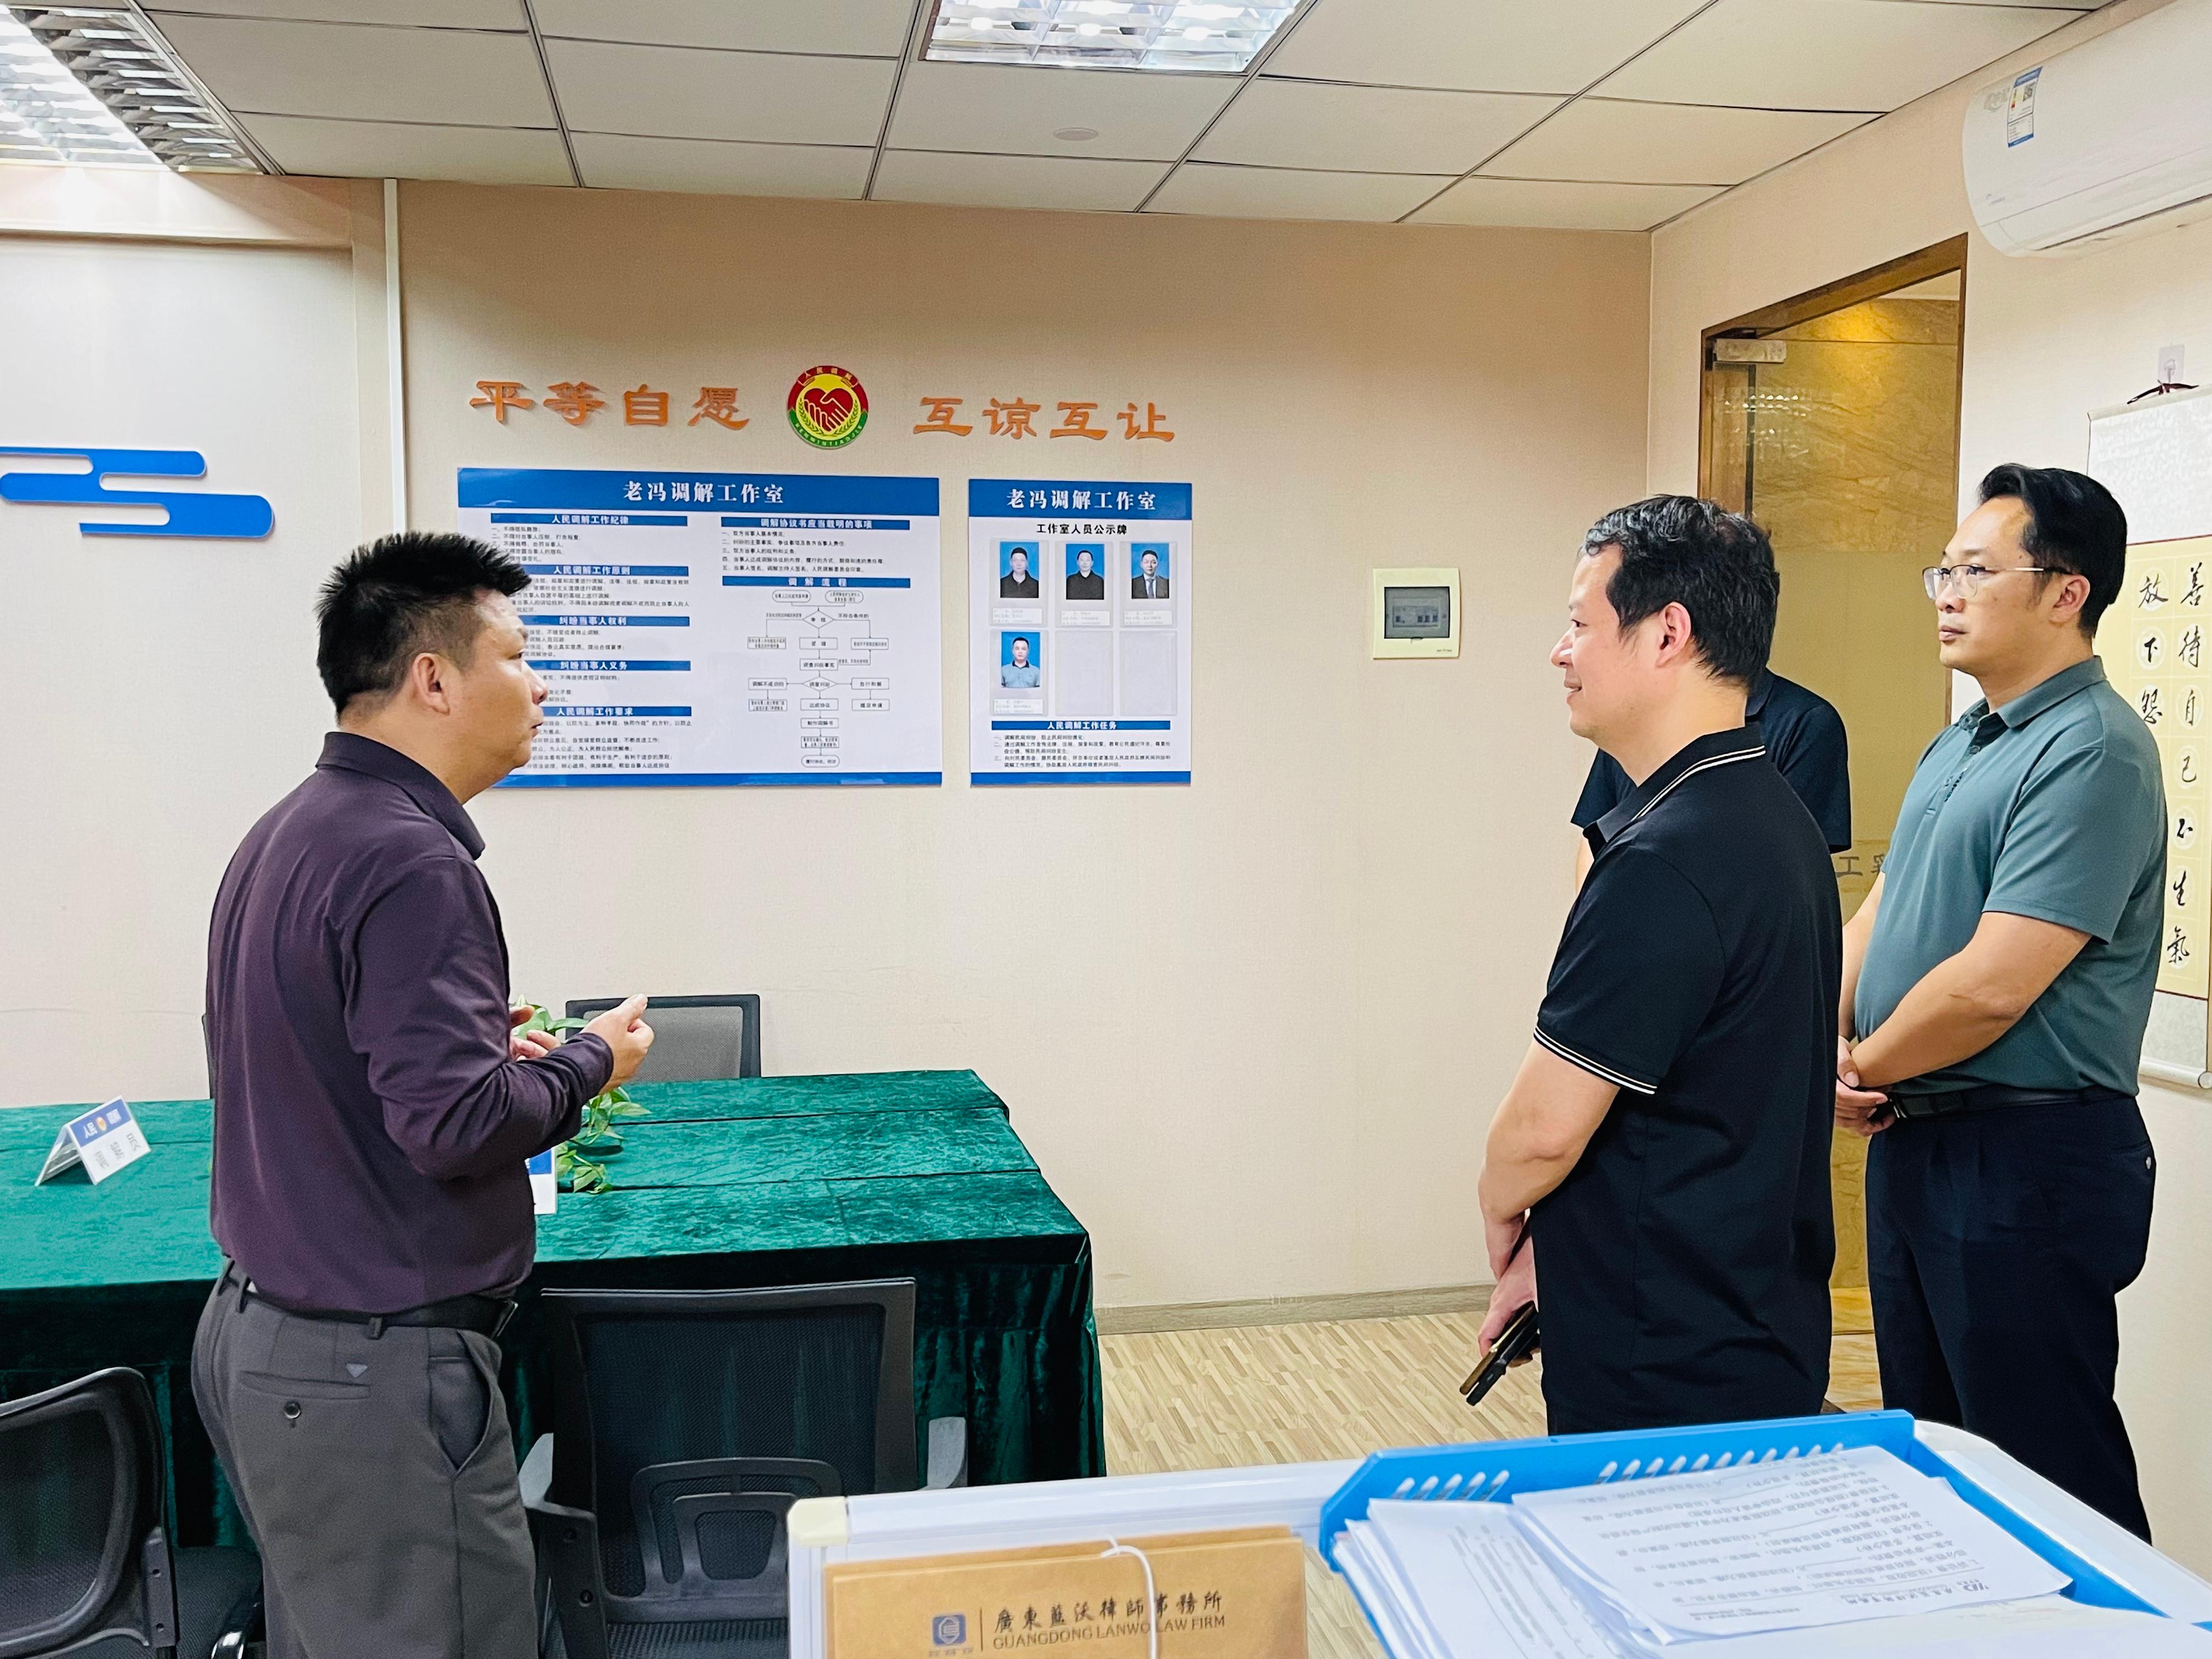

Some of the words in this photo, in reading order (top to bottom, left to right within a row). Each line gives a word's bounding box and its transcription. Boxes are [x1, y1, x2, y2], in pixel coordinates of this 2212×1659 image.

[470, 380, 751, 430] 平等自愿
[913, 397, 1175, 442] 互谅互让
[623, 481, 784, 504] 老冯调解工作室
[1006, 488, 1156, 511] 老冯调解工作室
[551, 515, 629, 525] 人民调解工作纪律
[760, 517, 872, 529] 调解协议书应当载明的事项
[1036, 523, 1128, 535] 工作室人员公示牌
[553, 566, 630, 576] 人民调解工作原则
[559, 616, 627, 626] 纠纷当事人权利
[560, 661, 628, 670] 纠纷当事人义务
[556, 707, 634, 716] 人民调解工作要求
[1047, 721, 1117, 730] 人民调解工作任务
[993, 1625, 1093, 1650] GUANGDONG
[1096, 1620, 1150, 1639] LANWO
[1192, 1615, 1225, 1630] FIRM
